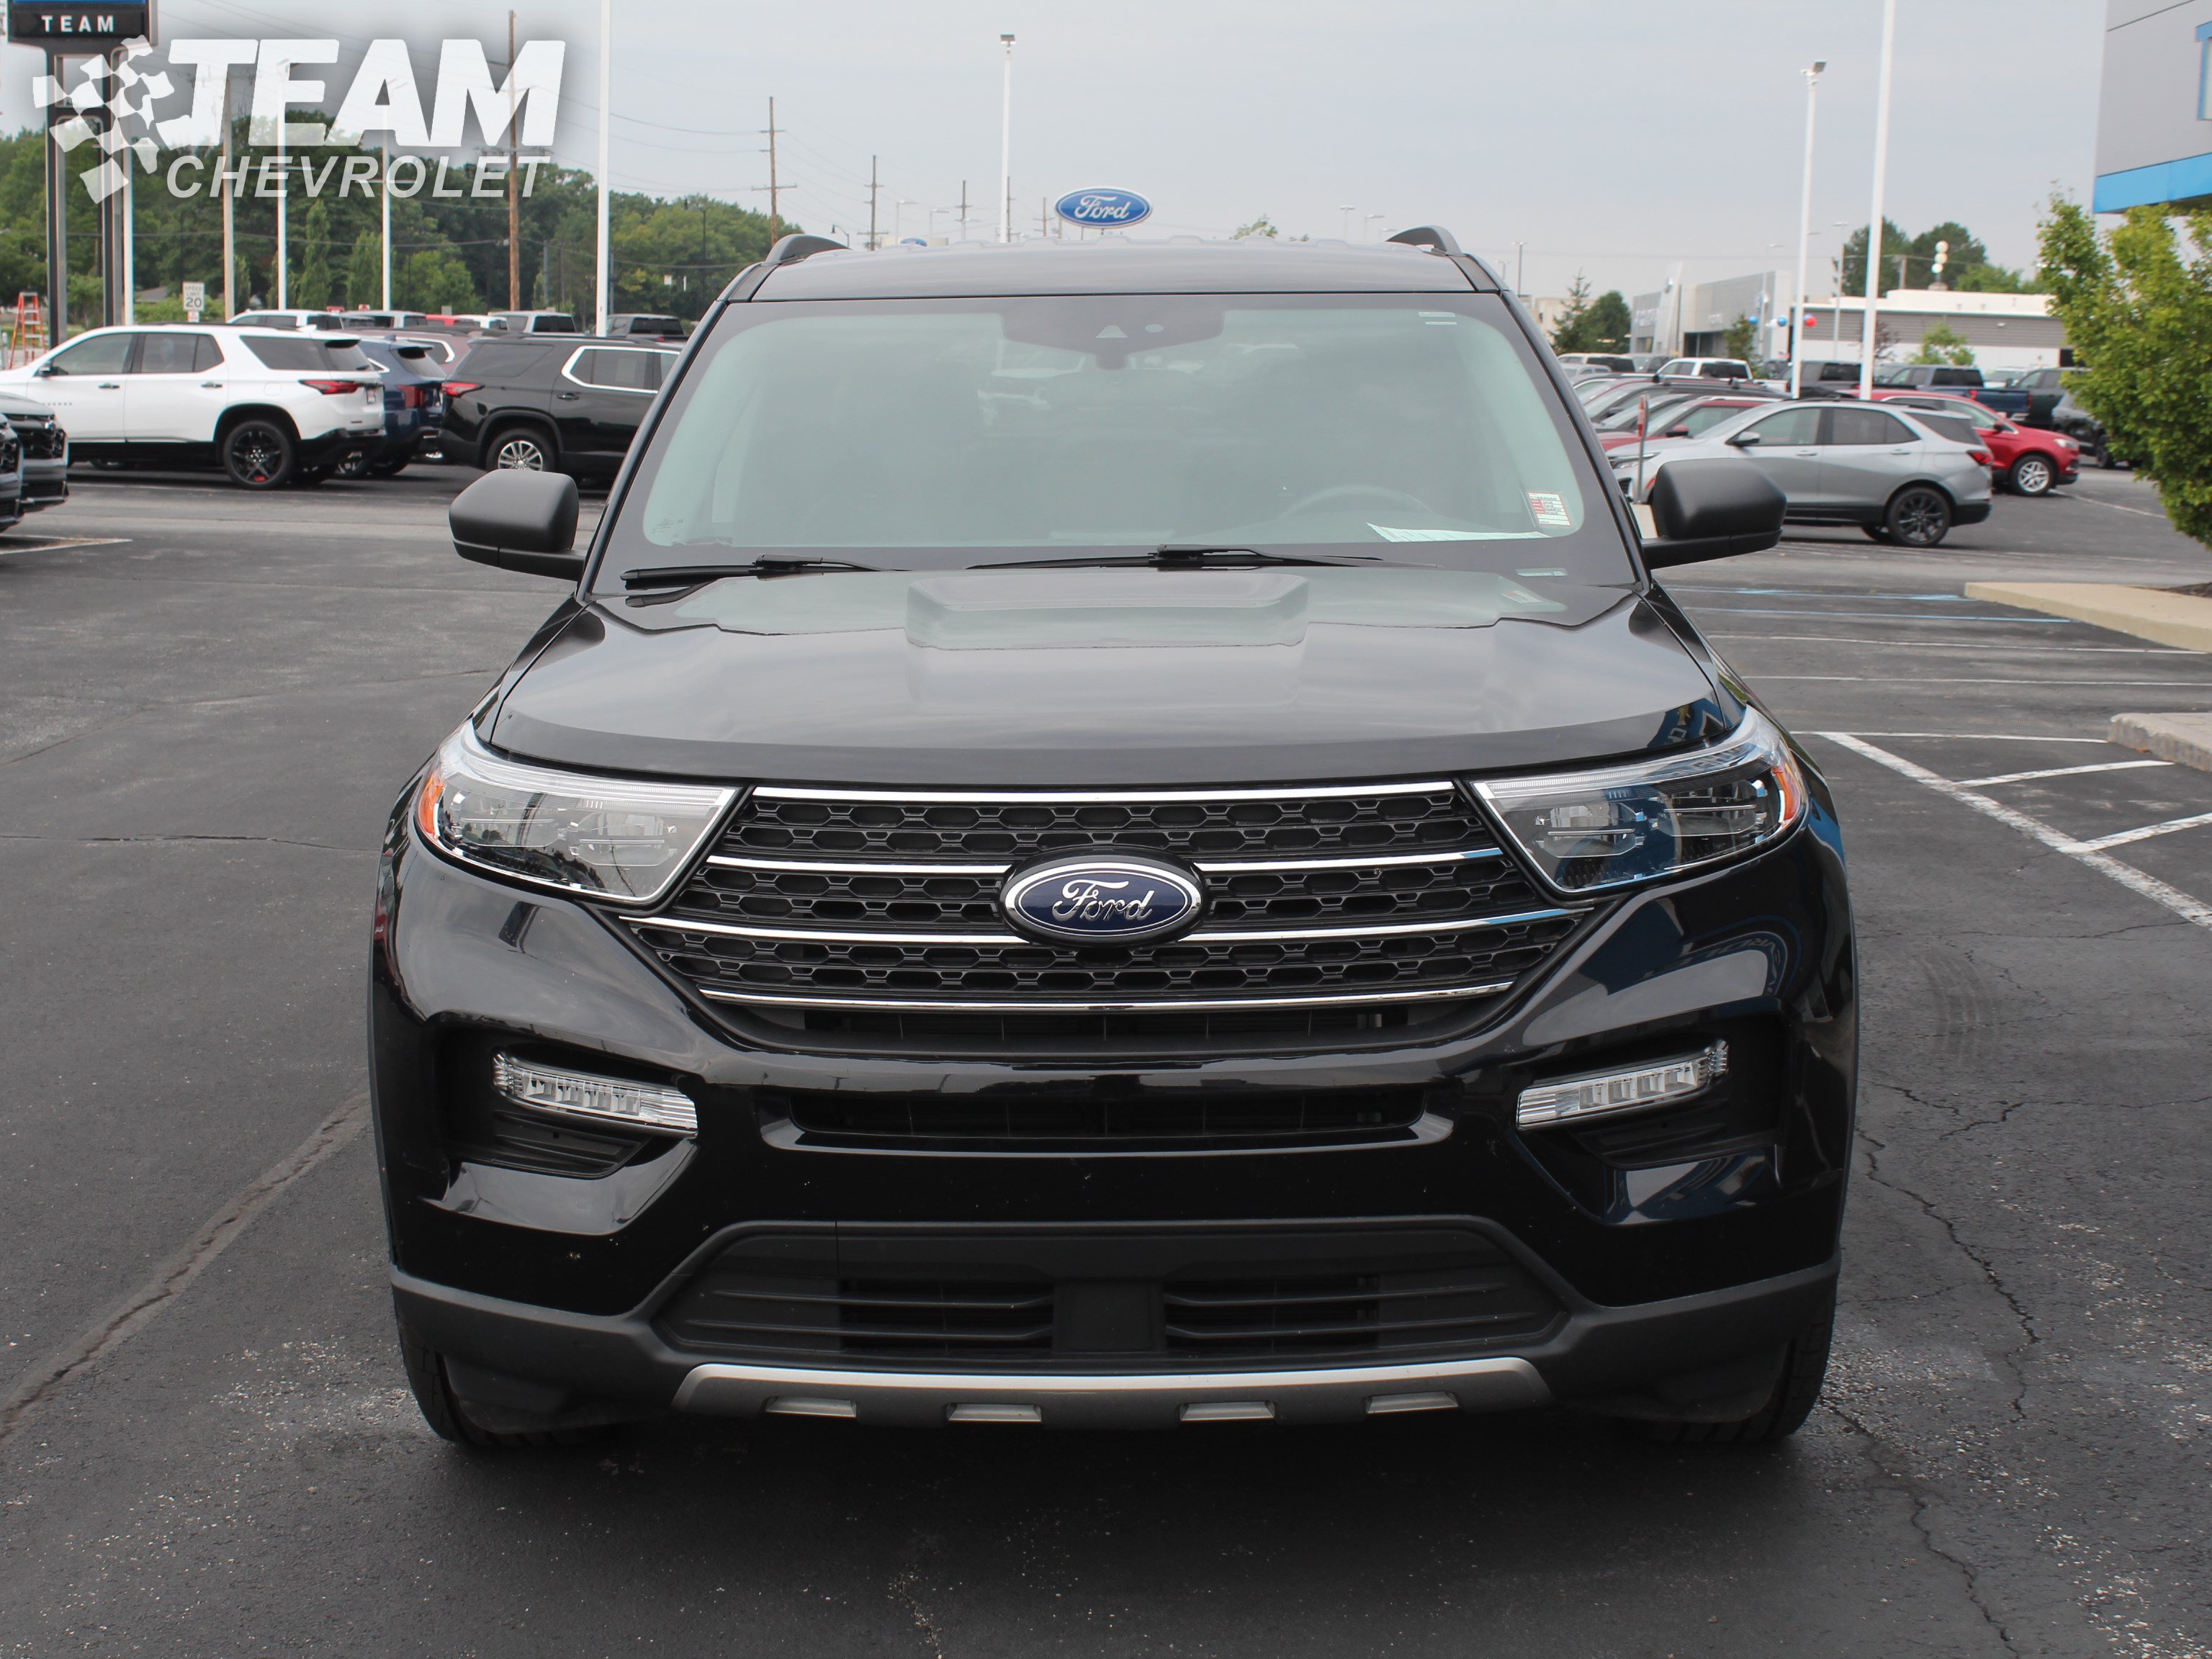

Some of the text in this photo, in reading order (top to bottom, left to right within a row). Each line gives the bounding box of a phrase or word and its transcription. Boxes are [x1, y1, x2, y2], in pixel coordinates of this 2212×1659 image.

[41, 14, 114, 32] TEAM
[1074, 194, 1132, 220] Ford
[186, 297, 202, 308] 20
[1052, 878, 1155, 922] Ford
